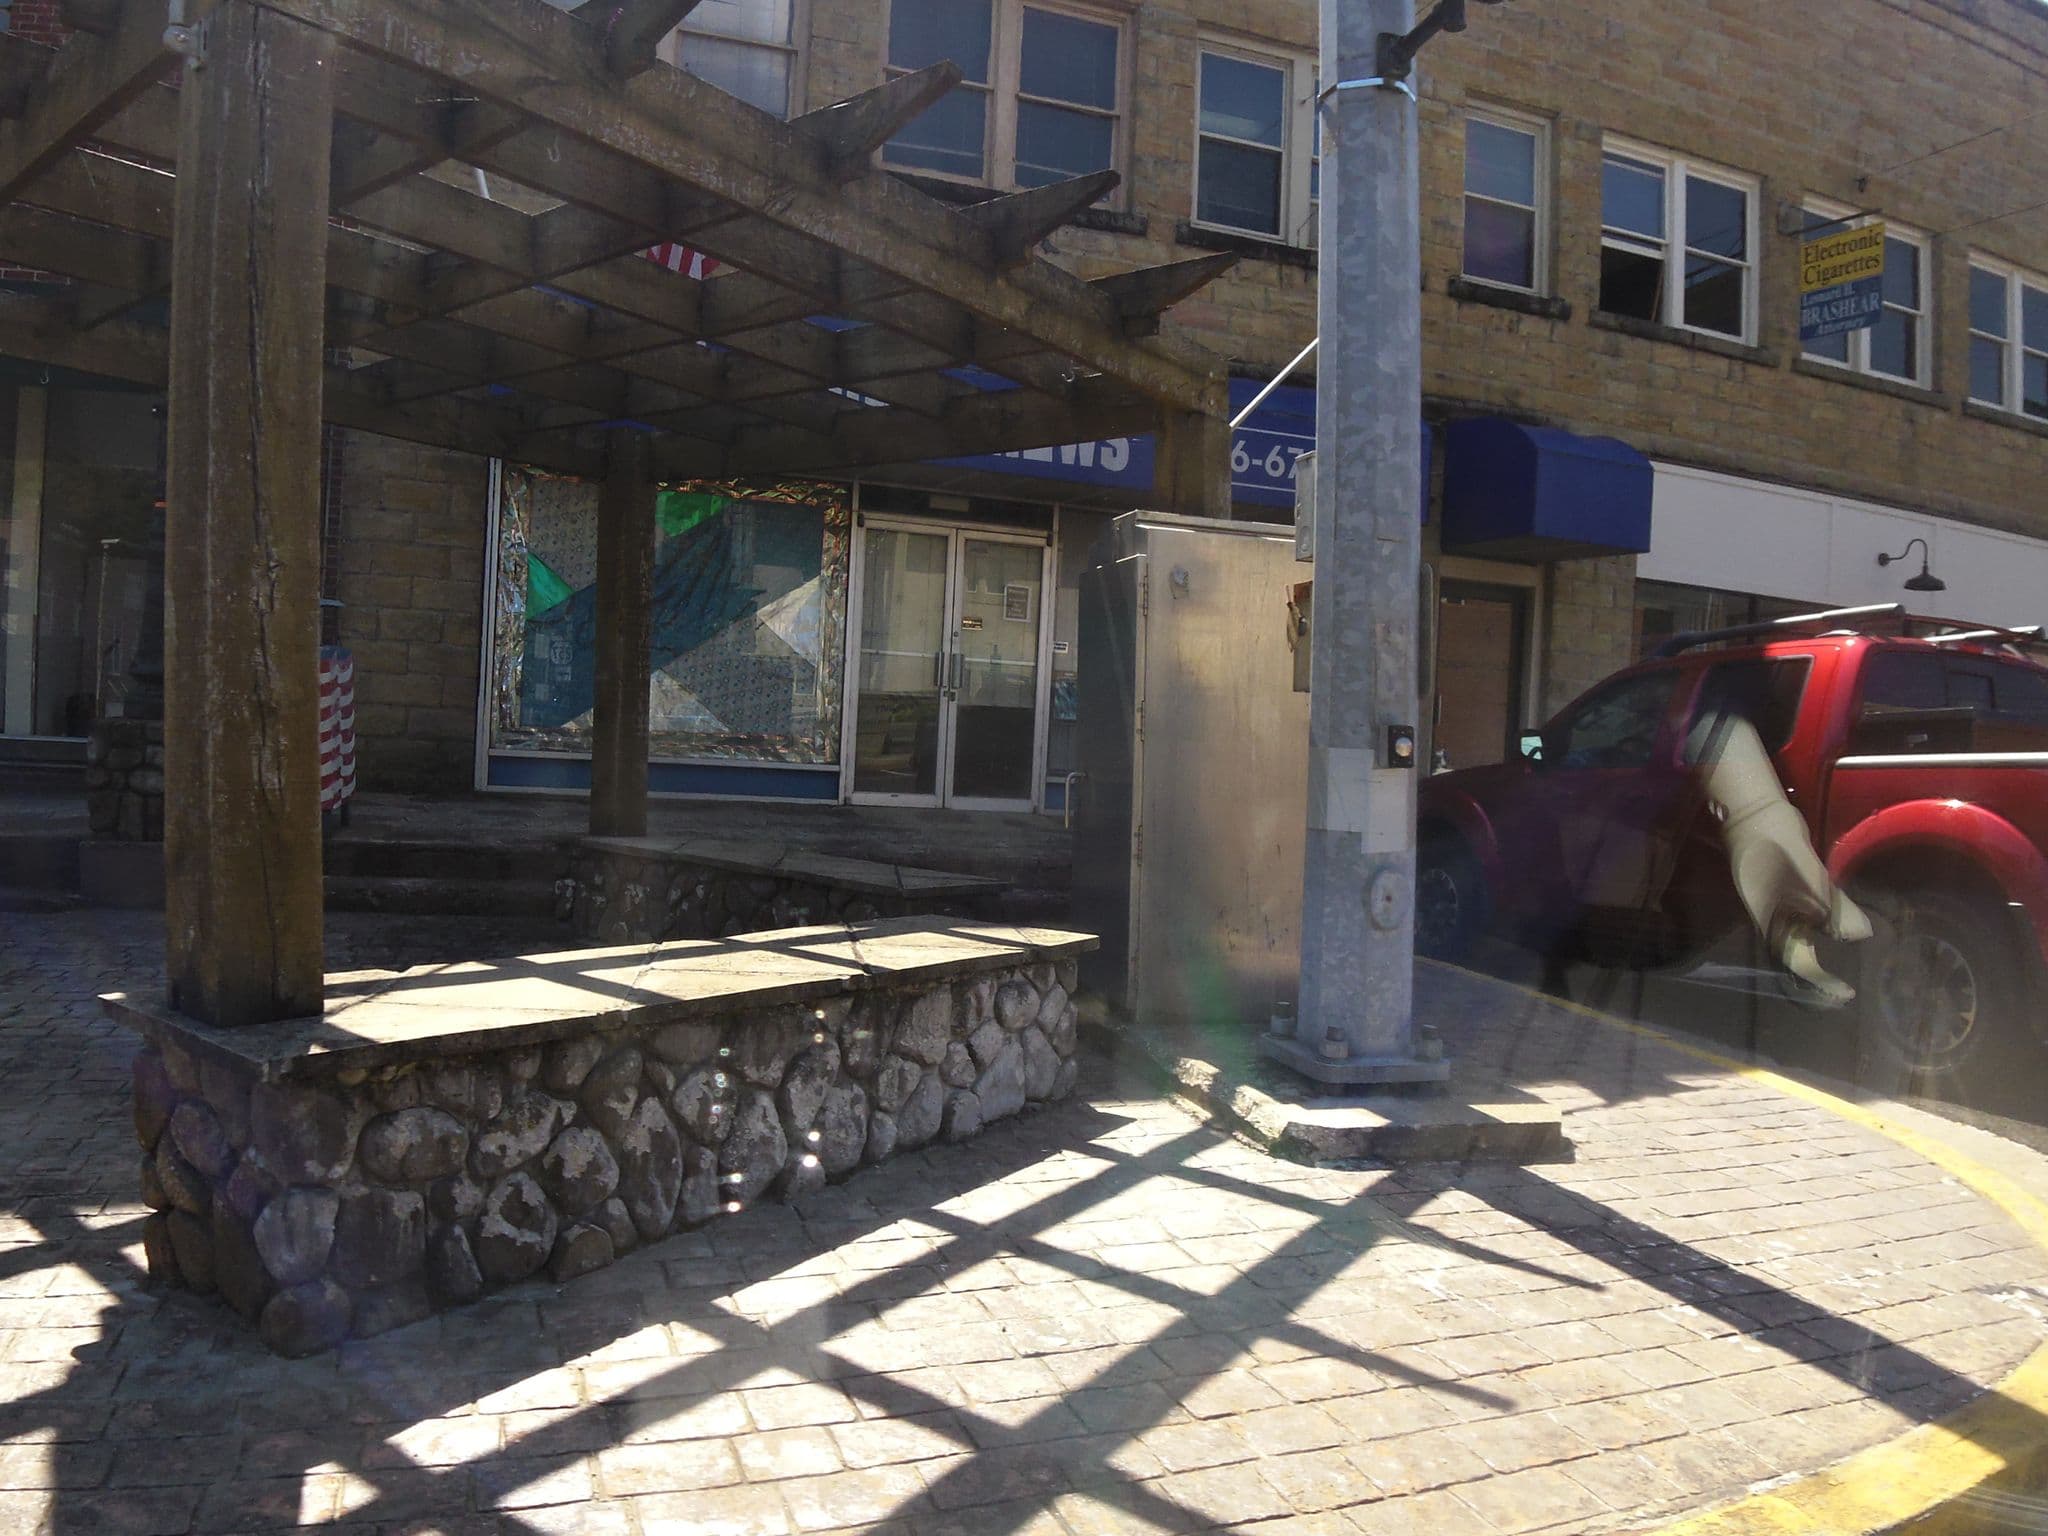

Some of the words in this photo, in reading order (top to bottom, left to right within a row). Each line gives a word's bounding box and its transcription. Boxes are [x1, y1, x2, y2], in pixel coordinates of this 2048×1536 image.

[1803, 229, 1882, 265] Electronic
[1803, 254, 1881, 286] Cigarettes
[1801, 292, 1881, 326] BRASHEAR
